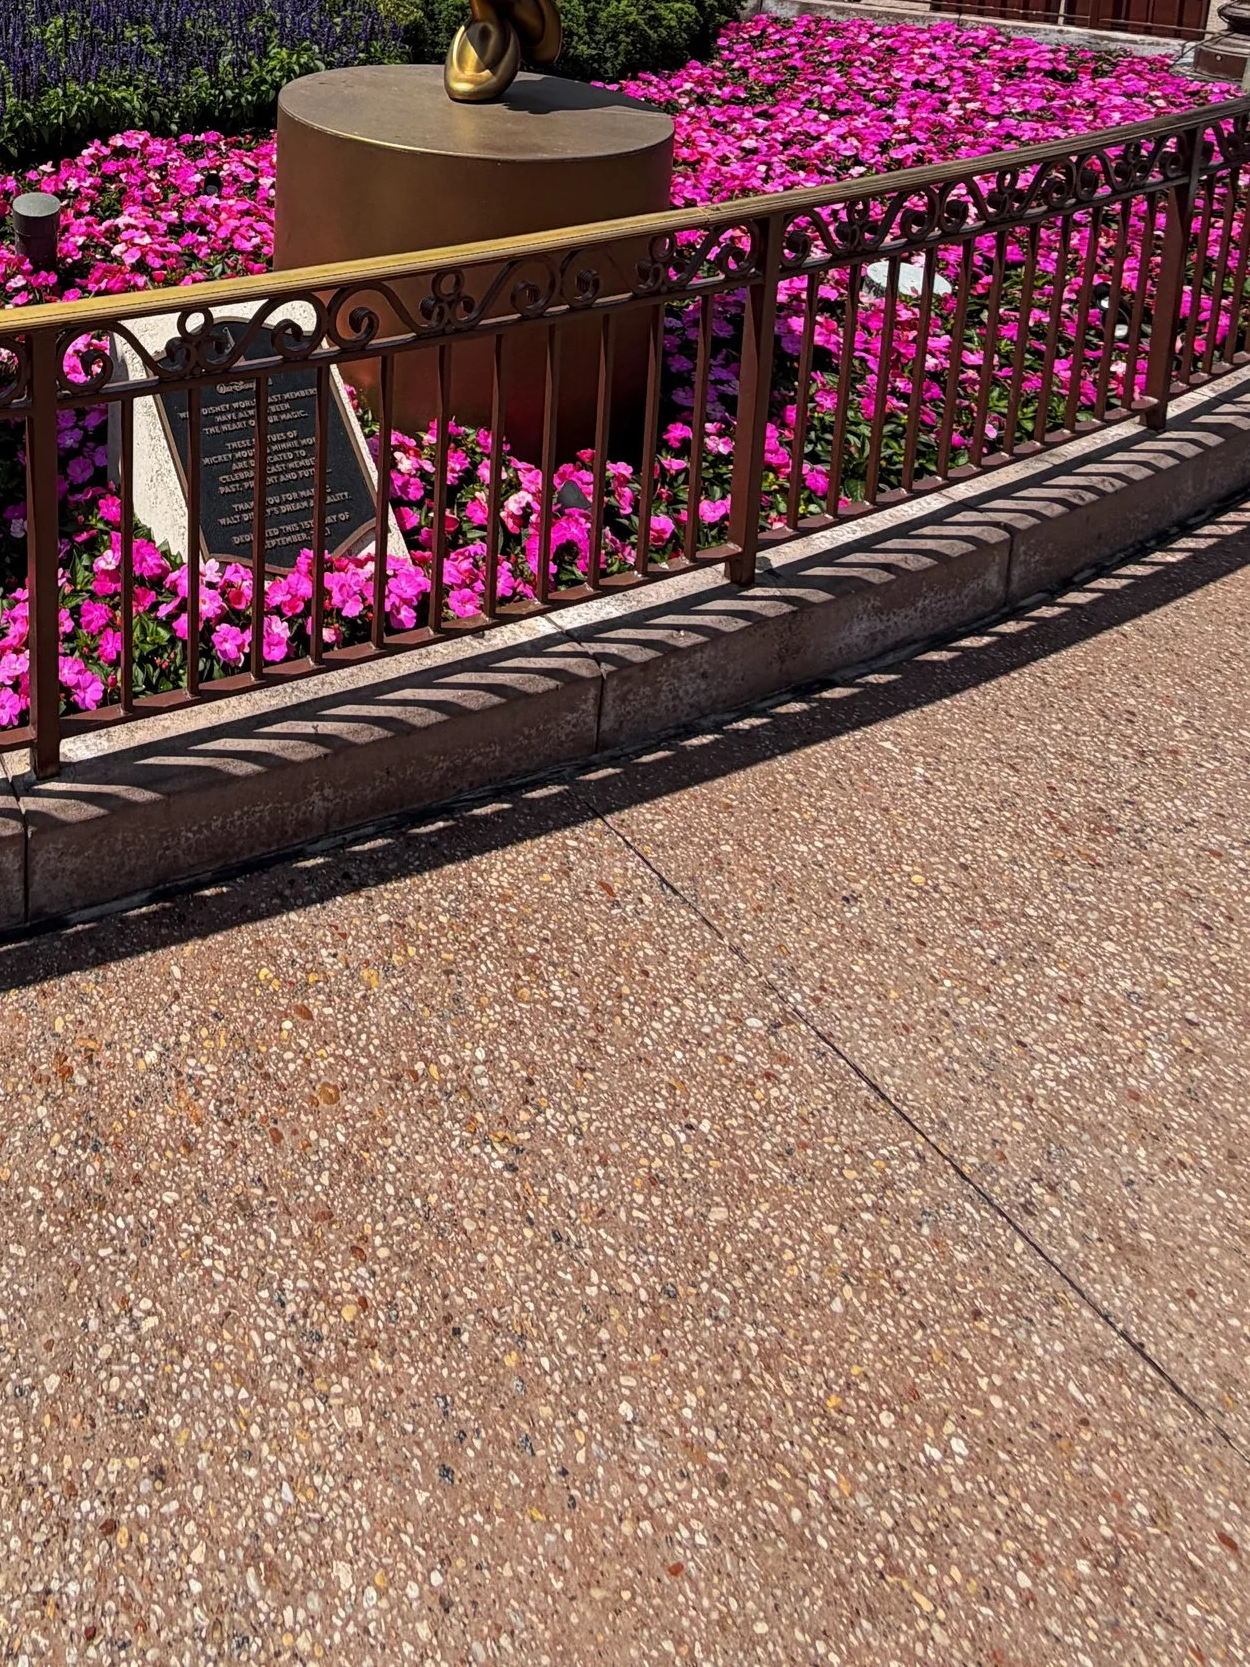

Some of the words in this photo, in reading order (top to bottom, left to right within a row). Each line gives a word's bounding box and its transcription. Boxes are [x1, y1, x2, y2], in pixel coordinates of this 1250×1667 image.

[201, 404, 230, 415] DISNEY
[268, 394, 281, 403] AST
[203, 425, 221, 435] THE
[221, 421, 247, 433] HEART
[215, 412, 237, 423] HAVE
[226, 439, 251, 449] THESE
[287, 430, 298, 439] OF
[203, 454, 232, 466] MICKEY
[270, 441, 299, 452] MINNIE
[232, 462, 248, 472] ARE
[295, 449, 306, 458] TO
[266, 464, 287, 474] CAST
[280, 472, 298, 482] AND
[232, 501, 254, 513] THAN
[266, 495, 280, 506] OU
[281, 492, 299, 503] FOR
[218, 514, 241, 526] WALT
[280, 501, 309, 514] DREAM
[279, 523, 300, 534] THIS
[325, 514, 338, 524] AY
[338, 511, 350, 521] OF
